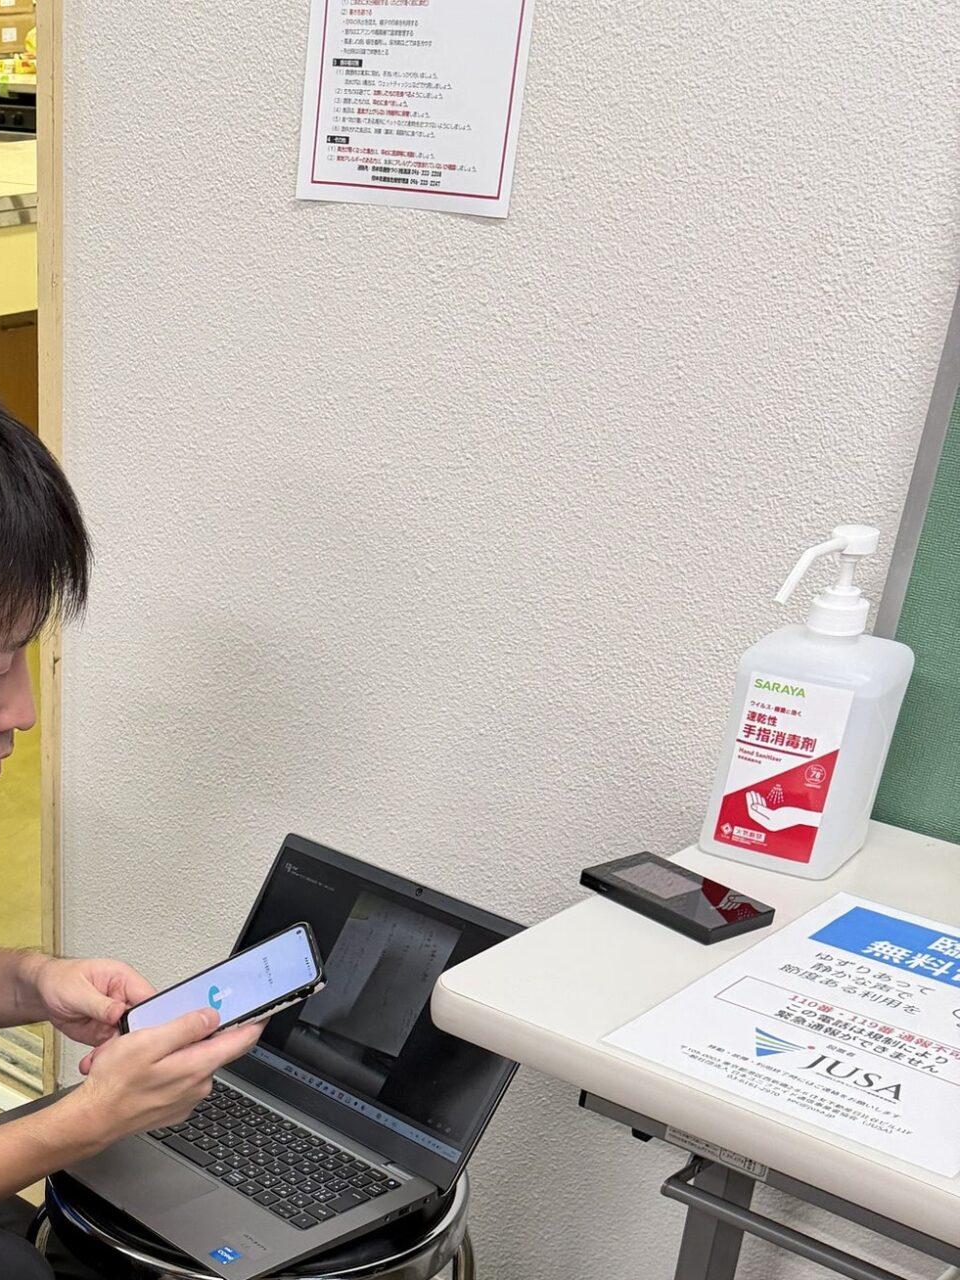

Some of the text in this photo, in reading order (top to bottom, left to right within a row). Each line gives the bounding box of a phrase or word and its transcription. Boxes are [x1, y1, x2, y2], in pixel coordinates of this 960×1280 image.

[754, 679, 806, 698] SARAYA
[742, 723, 817, 753] 手指消毒剤
[746, 710, 778, 727] 速乾性
[739, 747, 755, 756] Hand
[755, 751, 782, 762] Sanitizer
[779, 963, 921, 1015] 節度ある利用を
[810, 962, 914, 1000] 静かな声で
[815, 952, 936, 995] ゆずりあって
[774, 1009, 939, 1074] 緊急通報ができません
[785, 1003, 949, 1065] この電話は規制により
[798, 1054, 902, 1101] JUSA
